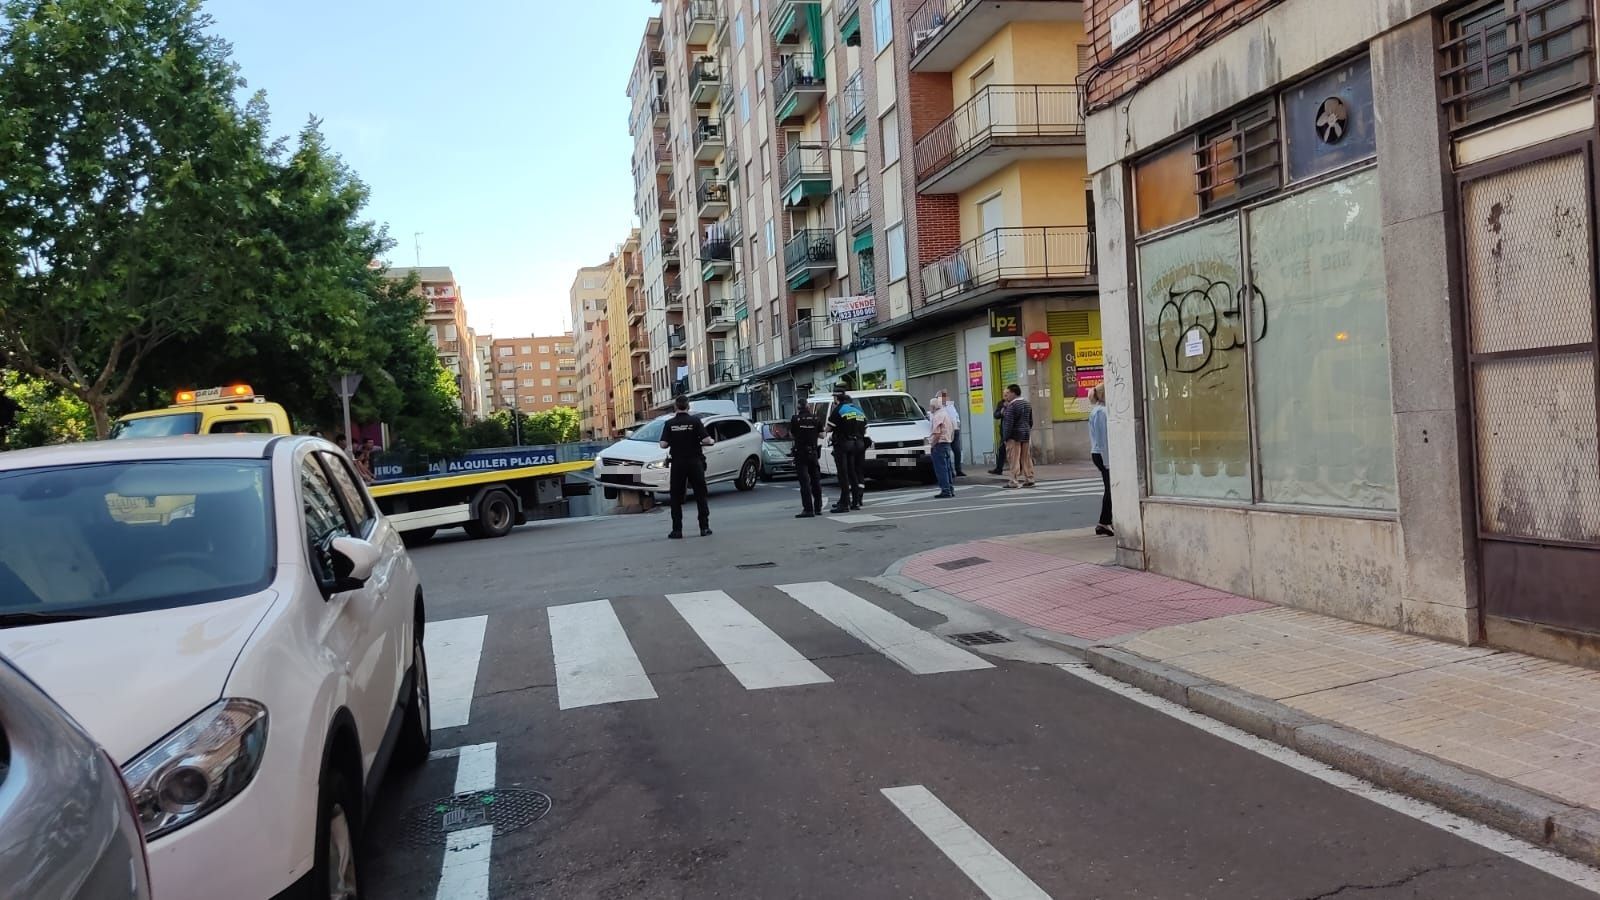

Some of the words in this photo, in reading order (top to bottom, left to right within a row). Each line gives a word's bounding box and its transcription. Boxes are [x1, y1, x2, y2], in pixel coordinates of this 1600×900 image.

[849, 300, 874, 309] VENDE
[449, 458, 508, 471] ALQUILER
[510, 455, 555, 467] PLAZAS
